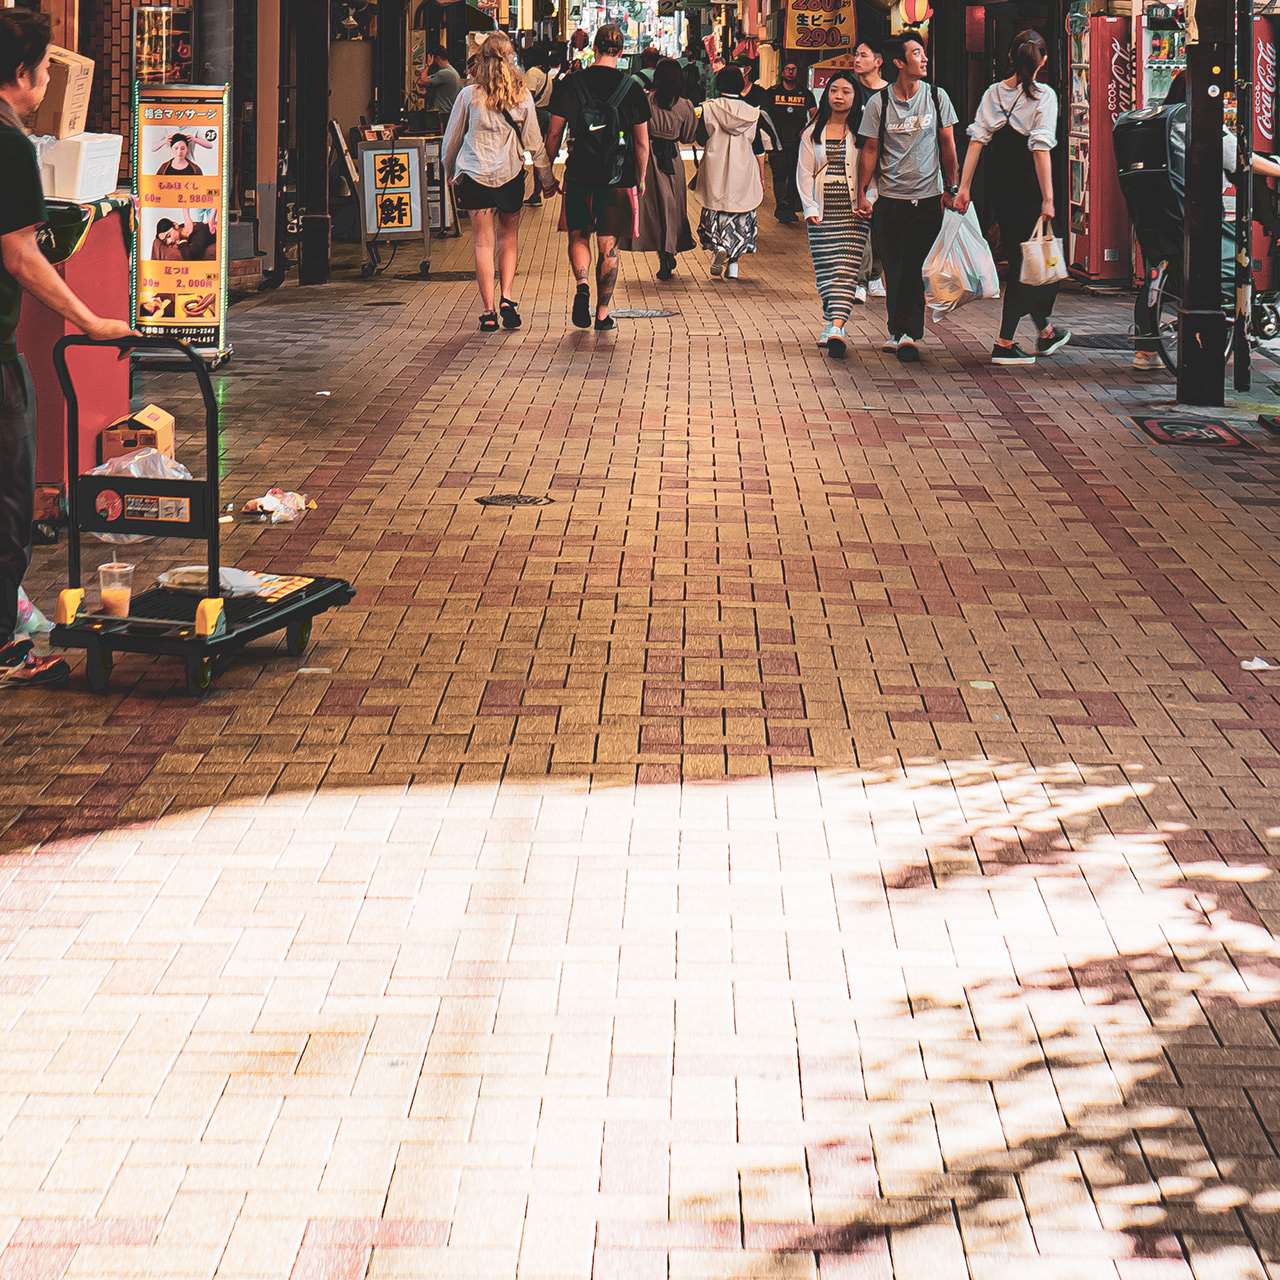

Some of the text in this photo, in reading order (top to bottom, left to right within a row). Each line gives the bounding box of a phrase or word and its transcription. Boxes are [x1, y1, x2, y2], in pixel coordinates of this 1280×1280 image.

[796, 13, 847, 27] 生ビール
[796, 27, 851, 48] 290円
[788, 95, 805, 104] NAVY
